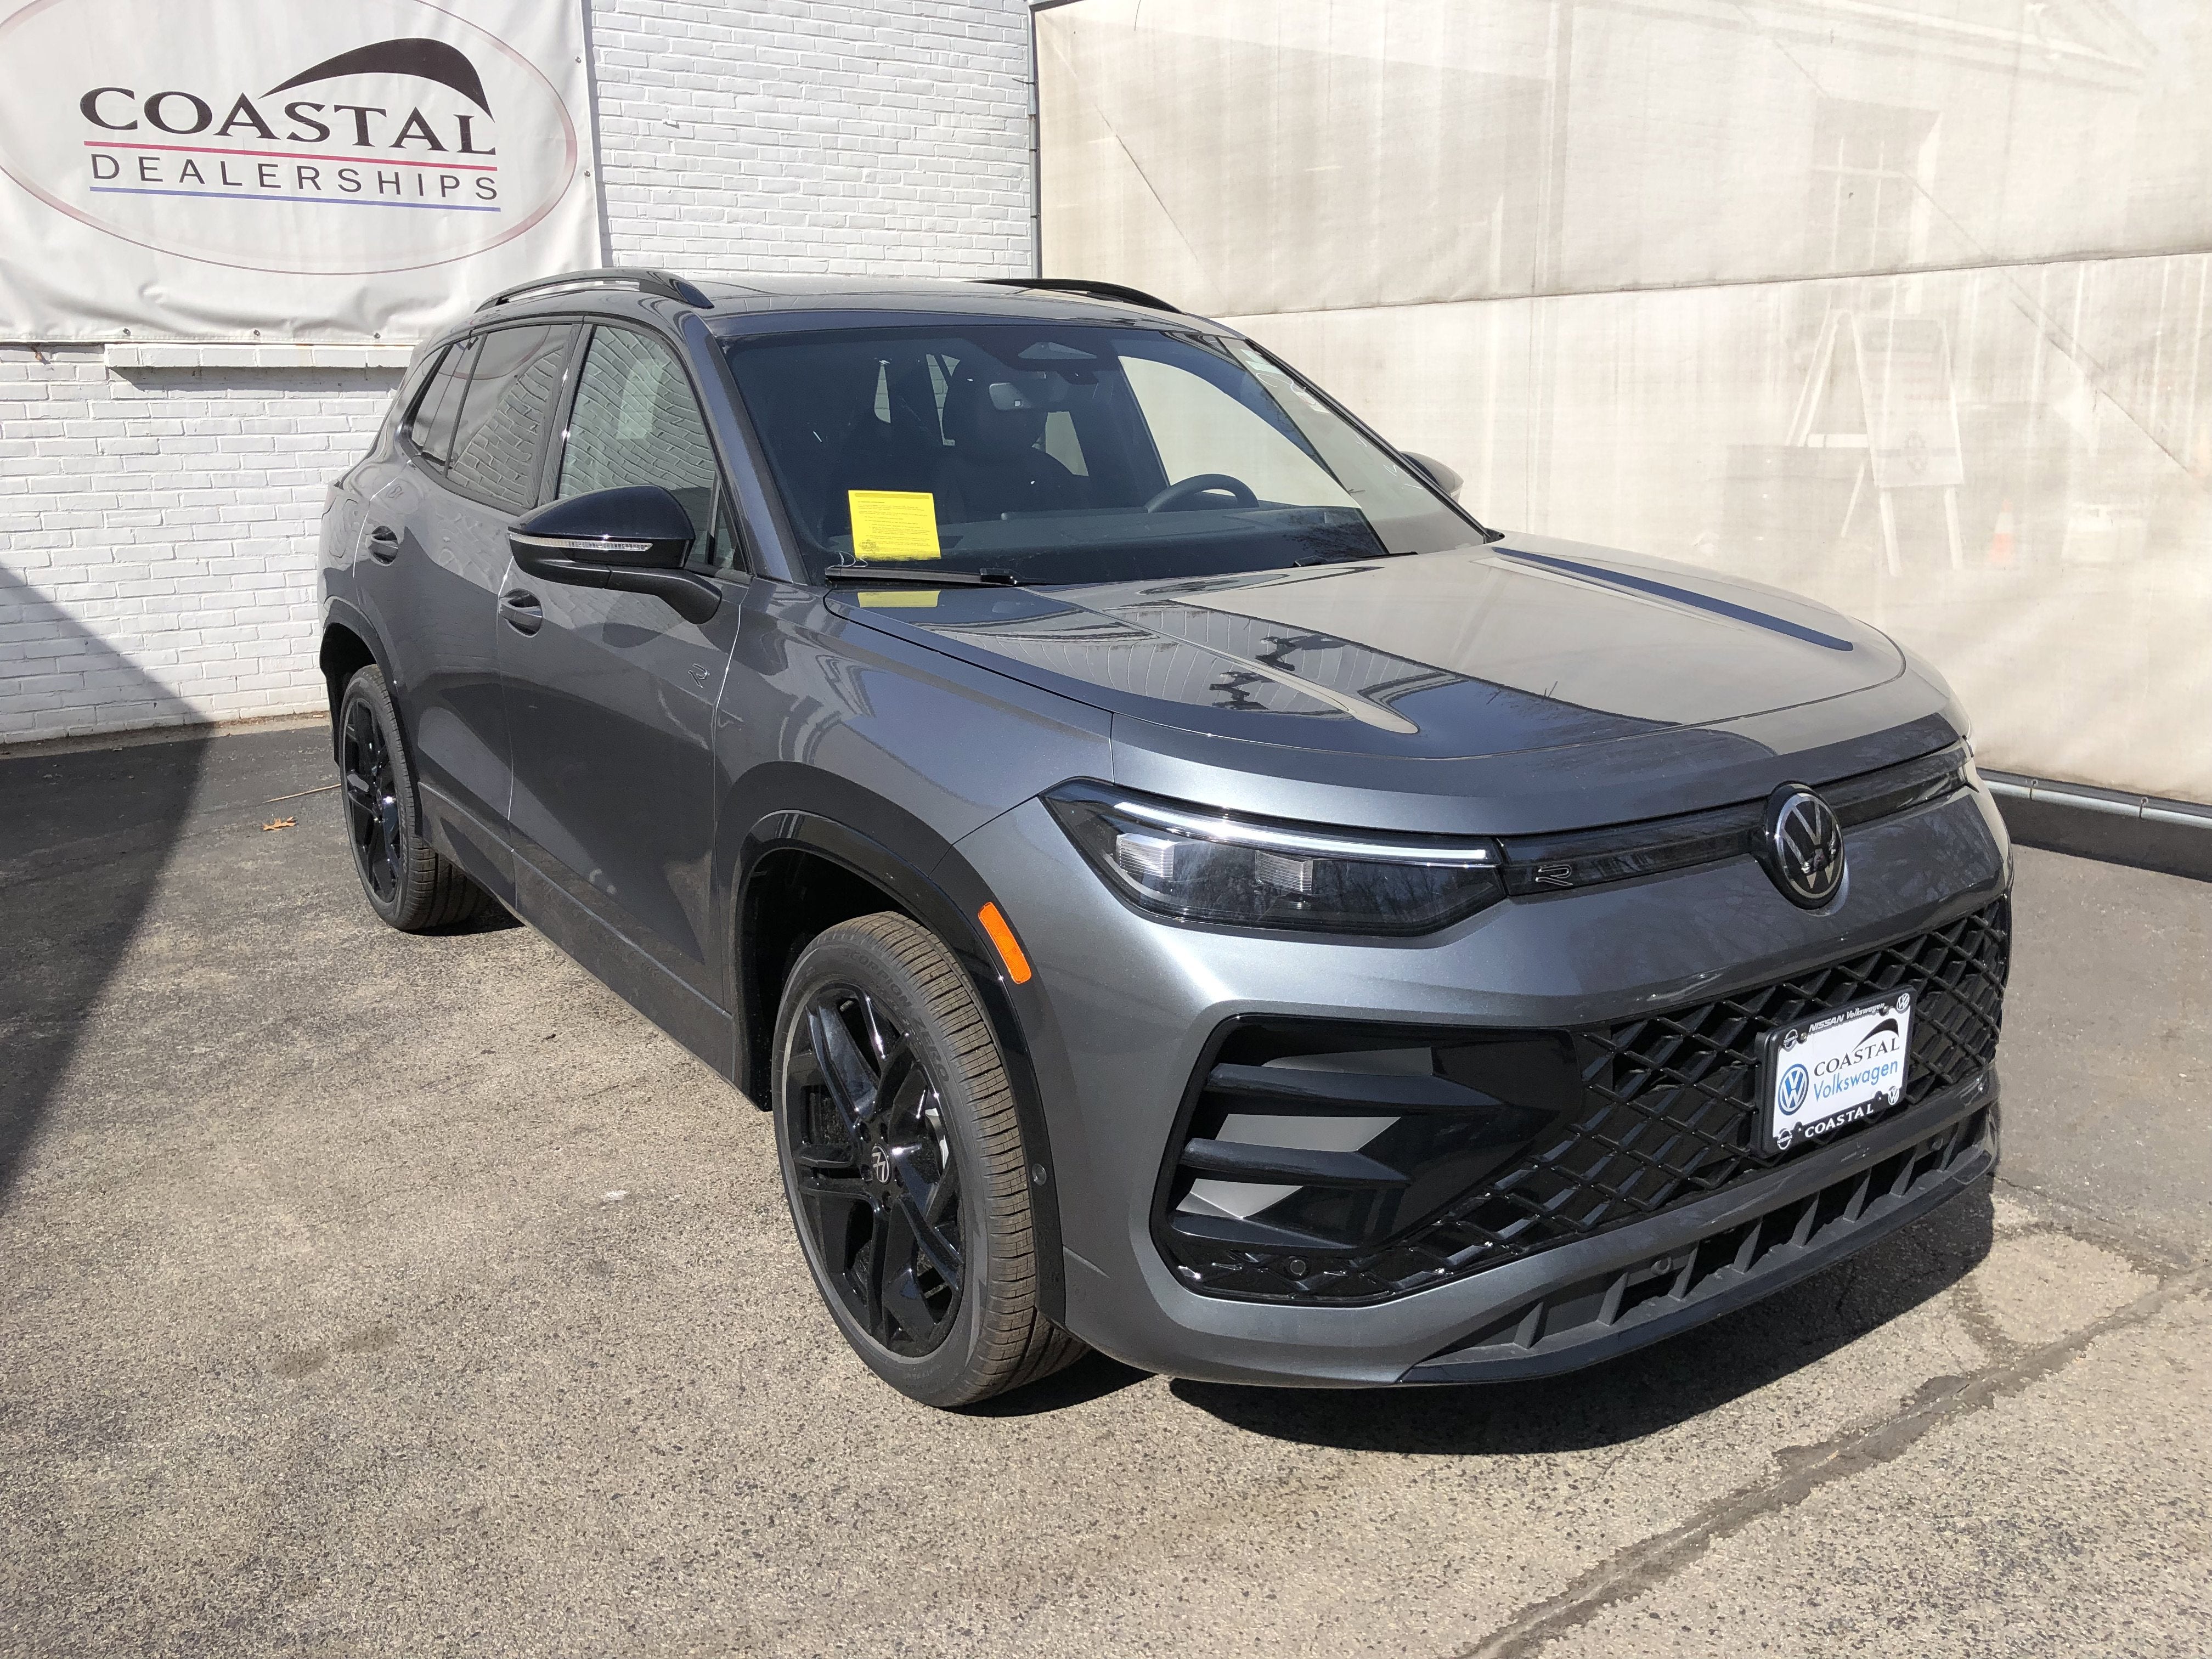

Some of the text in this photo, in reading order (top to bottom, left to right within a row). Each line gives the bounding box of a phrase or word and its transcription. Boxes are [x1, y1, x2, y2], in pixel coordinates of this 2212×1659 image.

[79, 87, 496, 156] COASTAL
[91, 154, 498, 201] DEALERSHIPS
[1809, 1003, 1885, 1032] NISSAN Volkswagen
[913, 1018, 950, 1083] ZERO
[1814, 1037, 1900, 1077] COASTAL
[1813, 1060, 1898, 1102] Volkswagen
[1804, 1104, 1874, 1138] COASTAL
